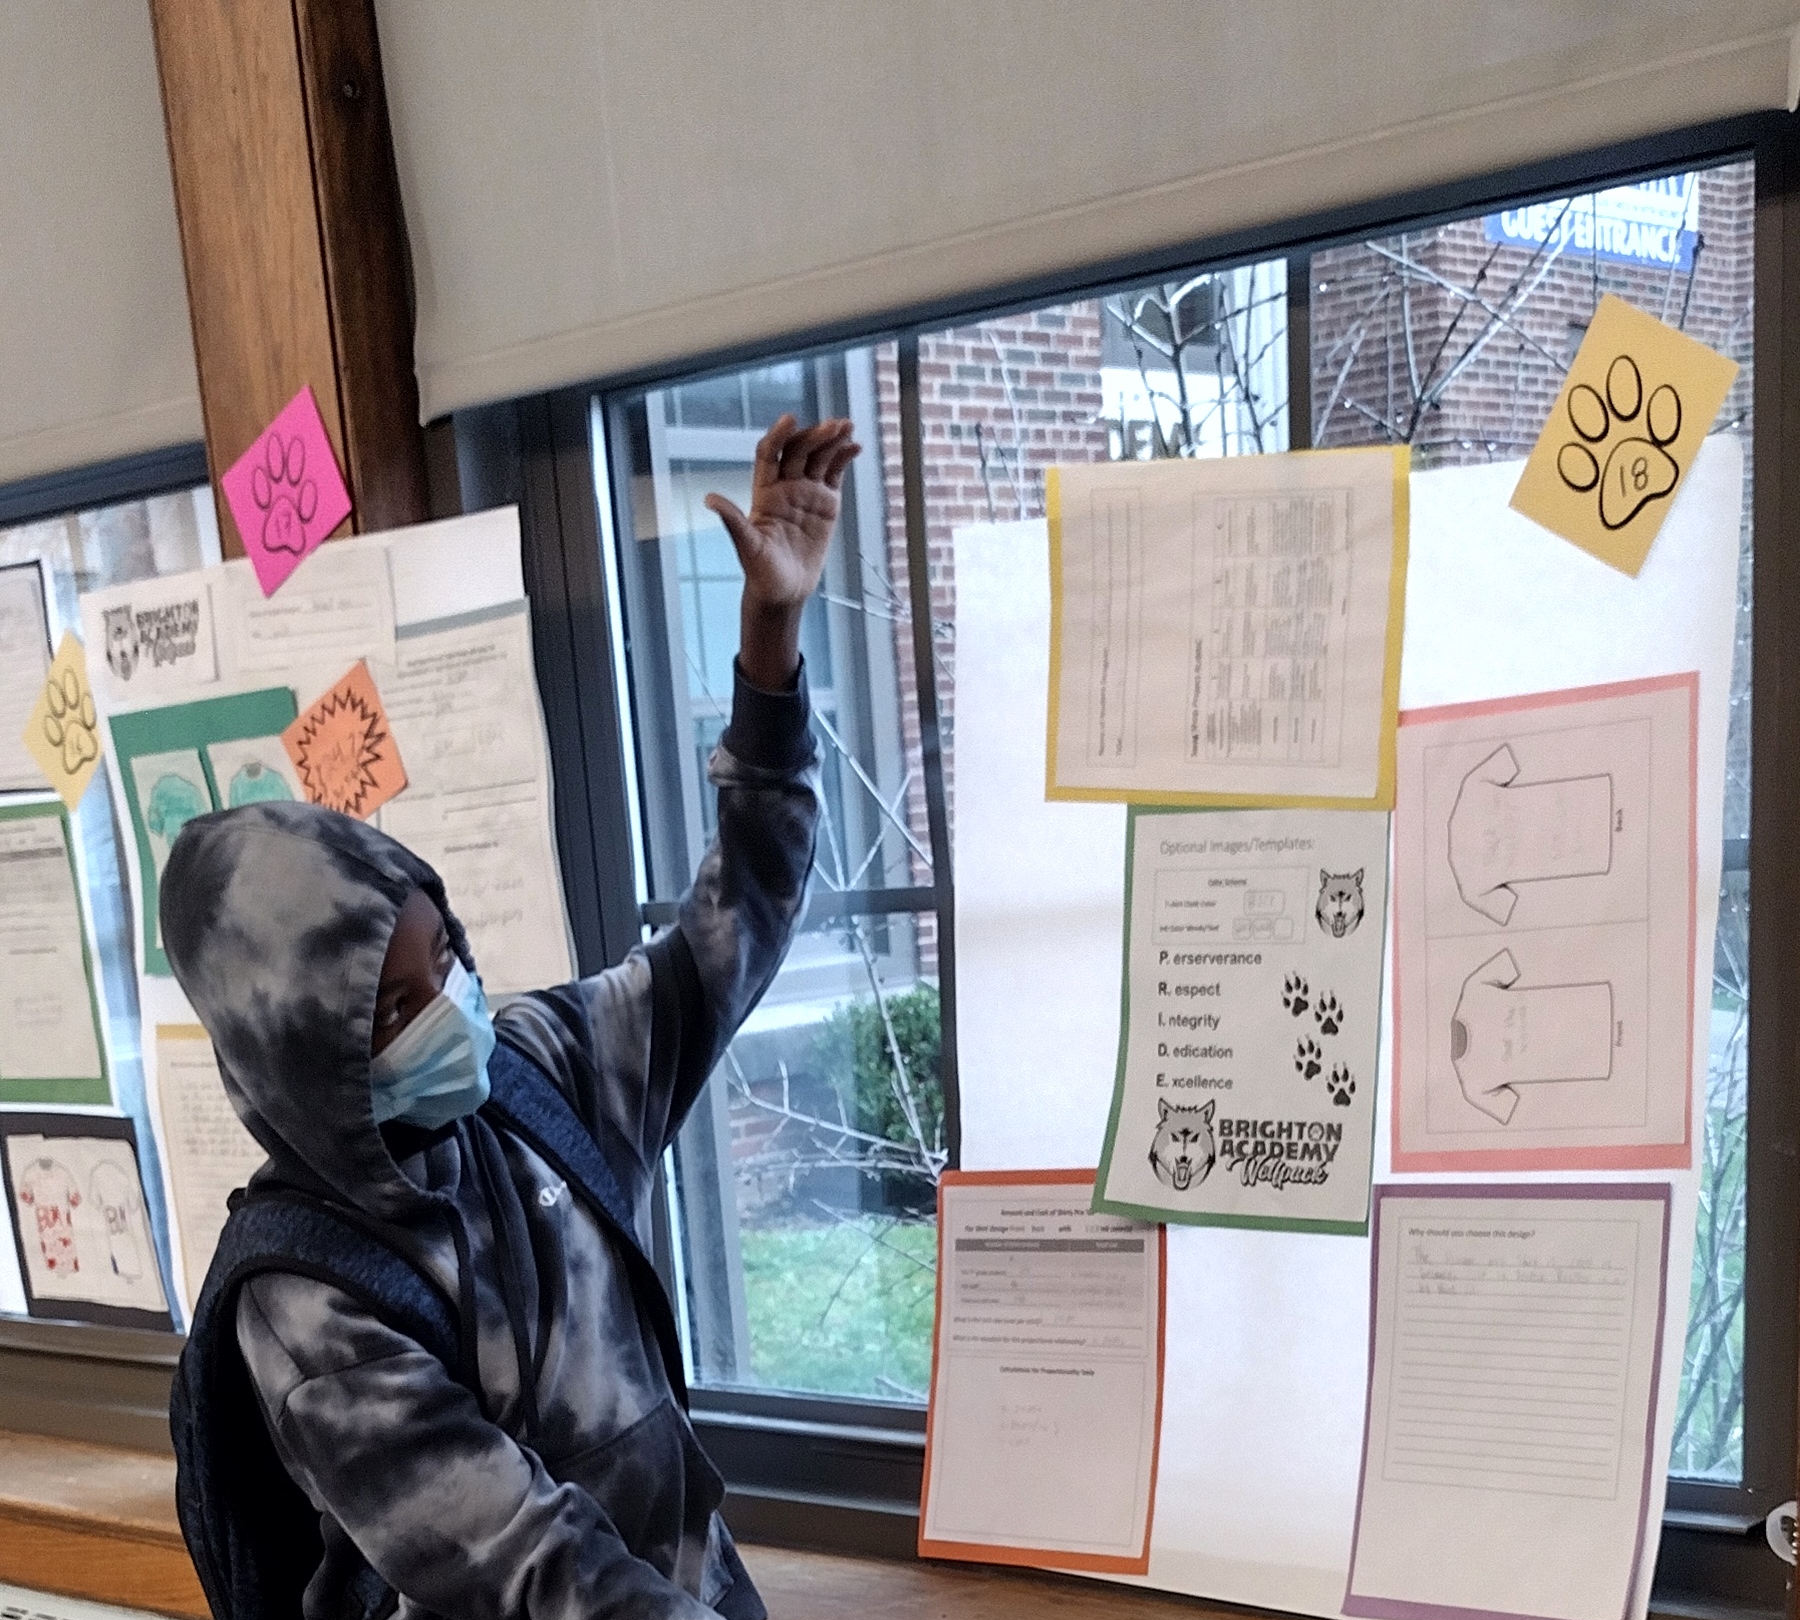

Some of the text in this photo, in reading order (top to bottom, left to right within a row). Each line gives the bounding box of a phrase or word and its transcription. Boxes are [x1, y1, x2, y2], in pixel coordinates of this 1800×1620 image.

[1501, 204, 1573, 244] GUEST
[1619, 455, 1649, 498] 18
[1159, 839, 1207, 856] Optional
[1173, 952, 1262, 965] erserverance
[1174, 981, 1221, 999] espect
[1169, 1014, 1221, 1031] ntegrity
[1173, 1044, 1233, 1059] edication
[1172, 1075, 1233, 1090] xcellence
[1219, 1119, 1342, 1142] BRIGHTON
[1220, 1139, 1340, 1162] ACADEMY
[1226, 1157, 1329, 1190] Wolfpack
